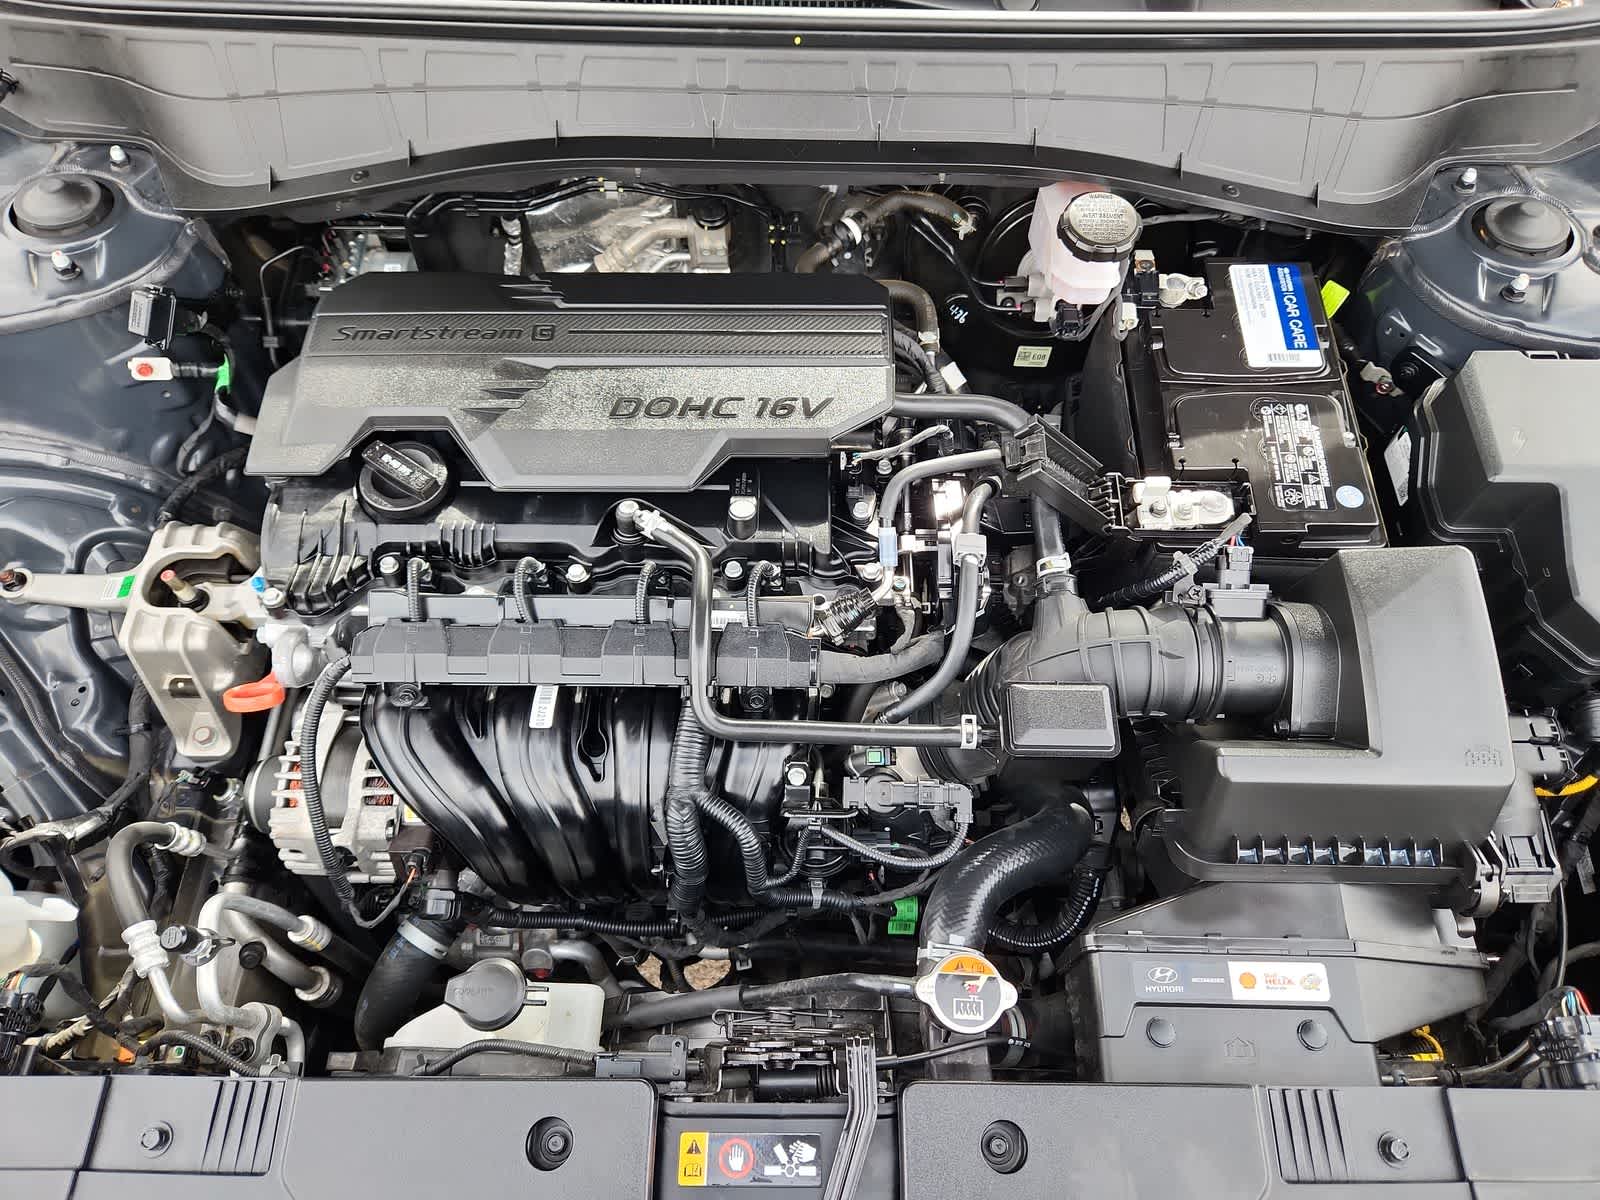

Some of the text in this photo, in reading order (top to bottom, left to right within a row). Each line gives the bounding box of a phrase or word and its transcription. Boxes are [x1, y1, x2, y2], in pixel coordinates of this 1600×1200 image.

[1283, 295, 1308, 349] CAR CARE
[331, 325, 524, 342] Smartstream
[608, 396, 835, 420] DOHC 16V
[1145, 985, 1184, 993] HYUNDAI
